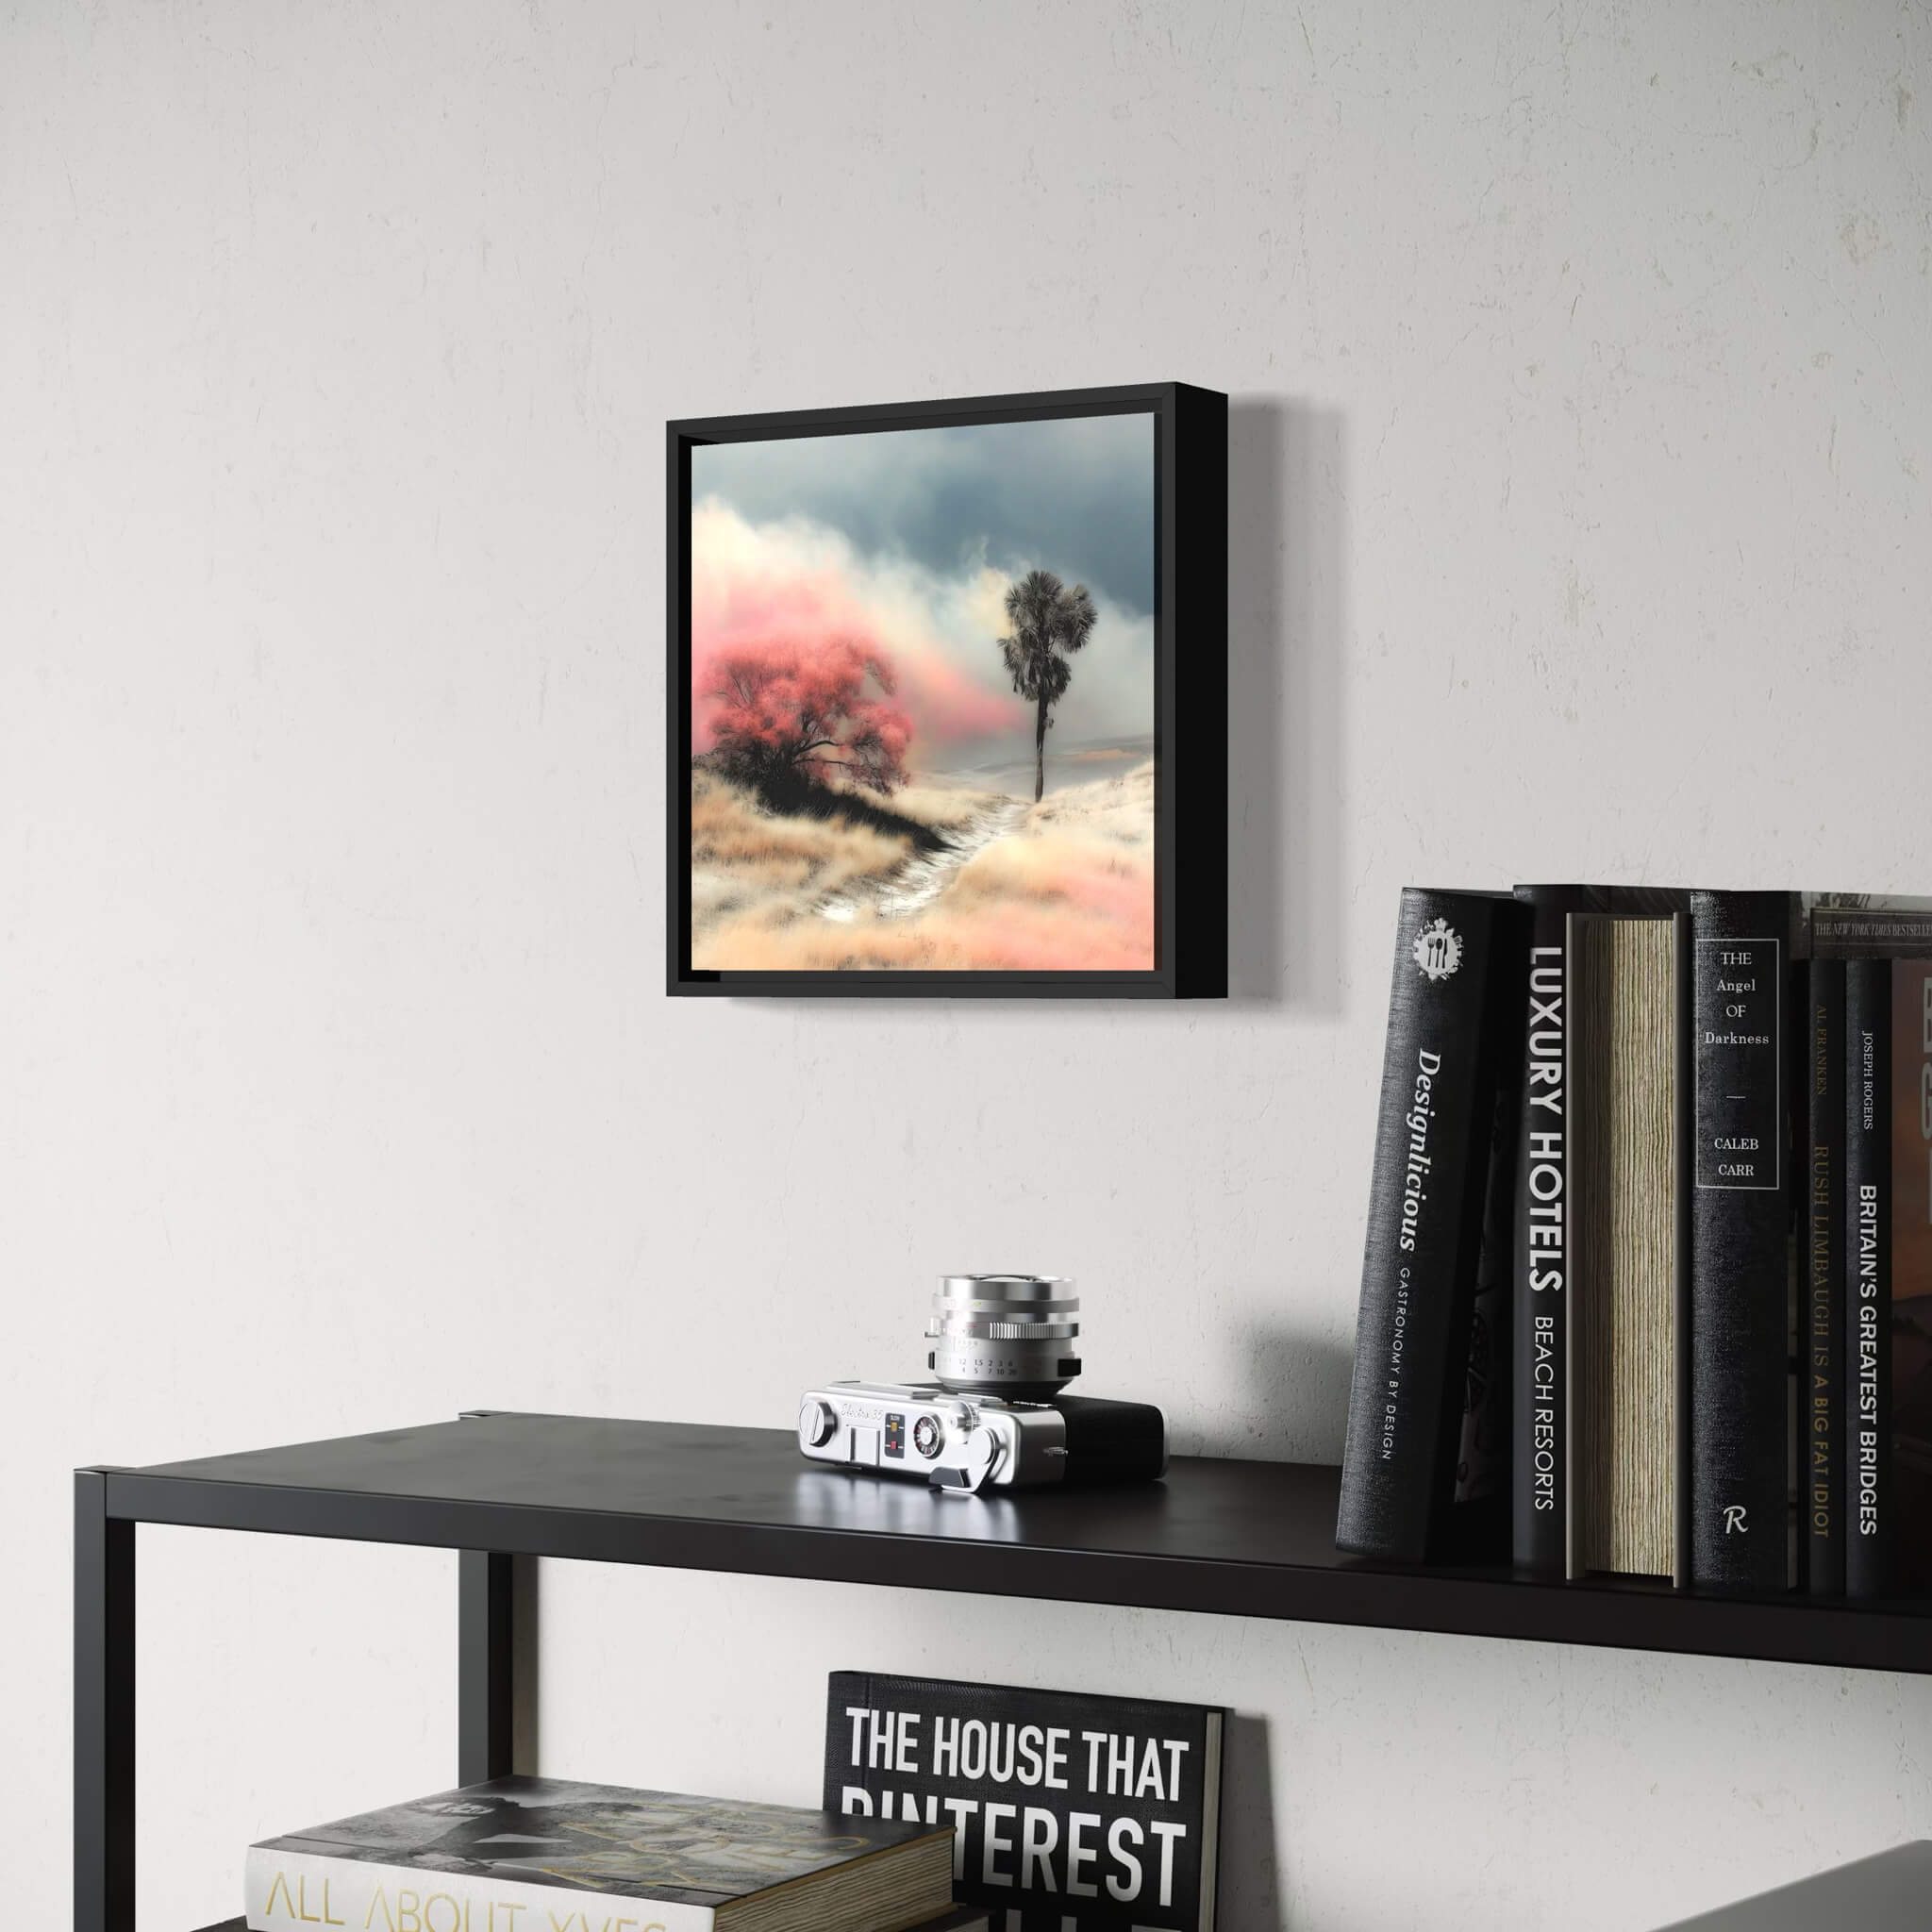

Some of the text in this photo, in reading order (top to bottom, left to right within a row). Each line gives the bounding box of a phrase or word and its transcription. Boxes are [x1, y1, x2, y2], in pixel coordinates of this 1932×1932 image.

[1721, 952, 1752, 964] THE
[1892, 924, 1932, 937] BESTSELLE
[1717, 979, 1756, 993] Angel
[1725, 1005, 1746, 1017] OF
[1704, 1031, 1770, 1044] Darkness
[1817, 1029, 1827, 1096] FRANKEN
[1862, 1030, 1874, 1131] JOSEPH ROGERS
[1400, 1048, 1441, 1252] Designlicious
[1529, 947, 1562, 1292] LUXURY HOTELS
[1714, 1138, 1758, 1150] CALEB
[1718, 1164, 1754, 1175] CARR
[1382, 1267, 1411, 1460] GASTRONOMY BY DESIGN
[1813, 1145, 1829, 1538] RUSH LIMBAUGH IS A BIG FAT IDIOT
[1859, 1185, 1877, 1536] BRITAIN'S GREATEST BRIDGES
[1535, 1317, 1554, 1510] BEACH RESORTS
[845, 1707, 1190, 1802] THE HOUSE THAT
[265, 1871, 346, 1925] ALL
[363, 1879, 527, 1932] ABOUT
